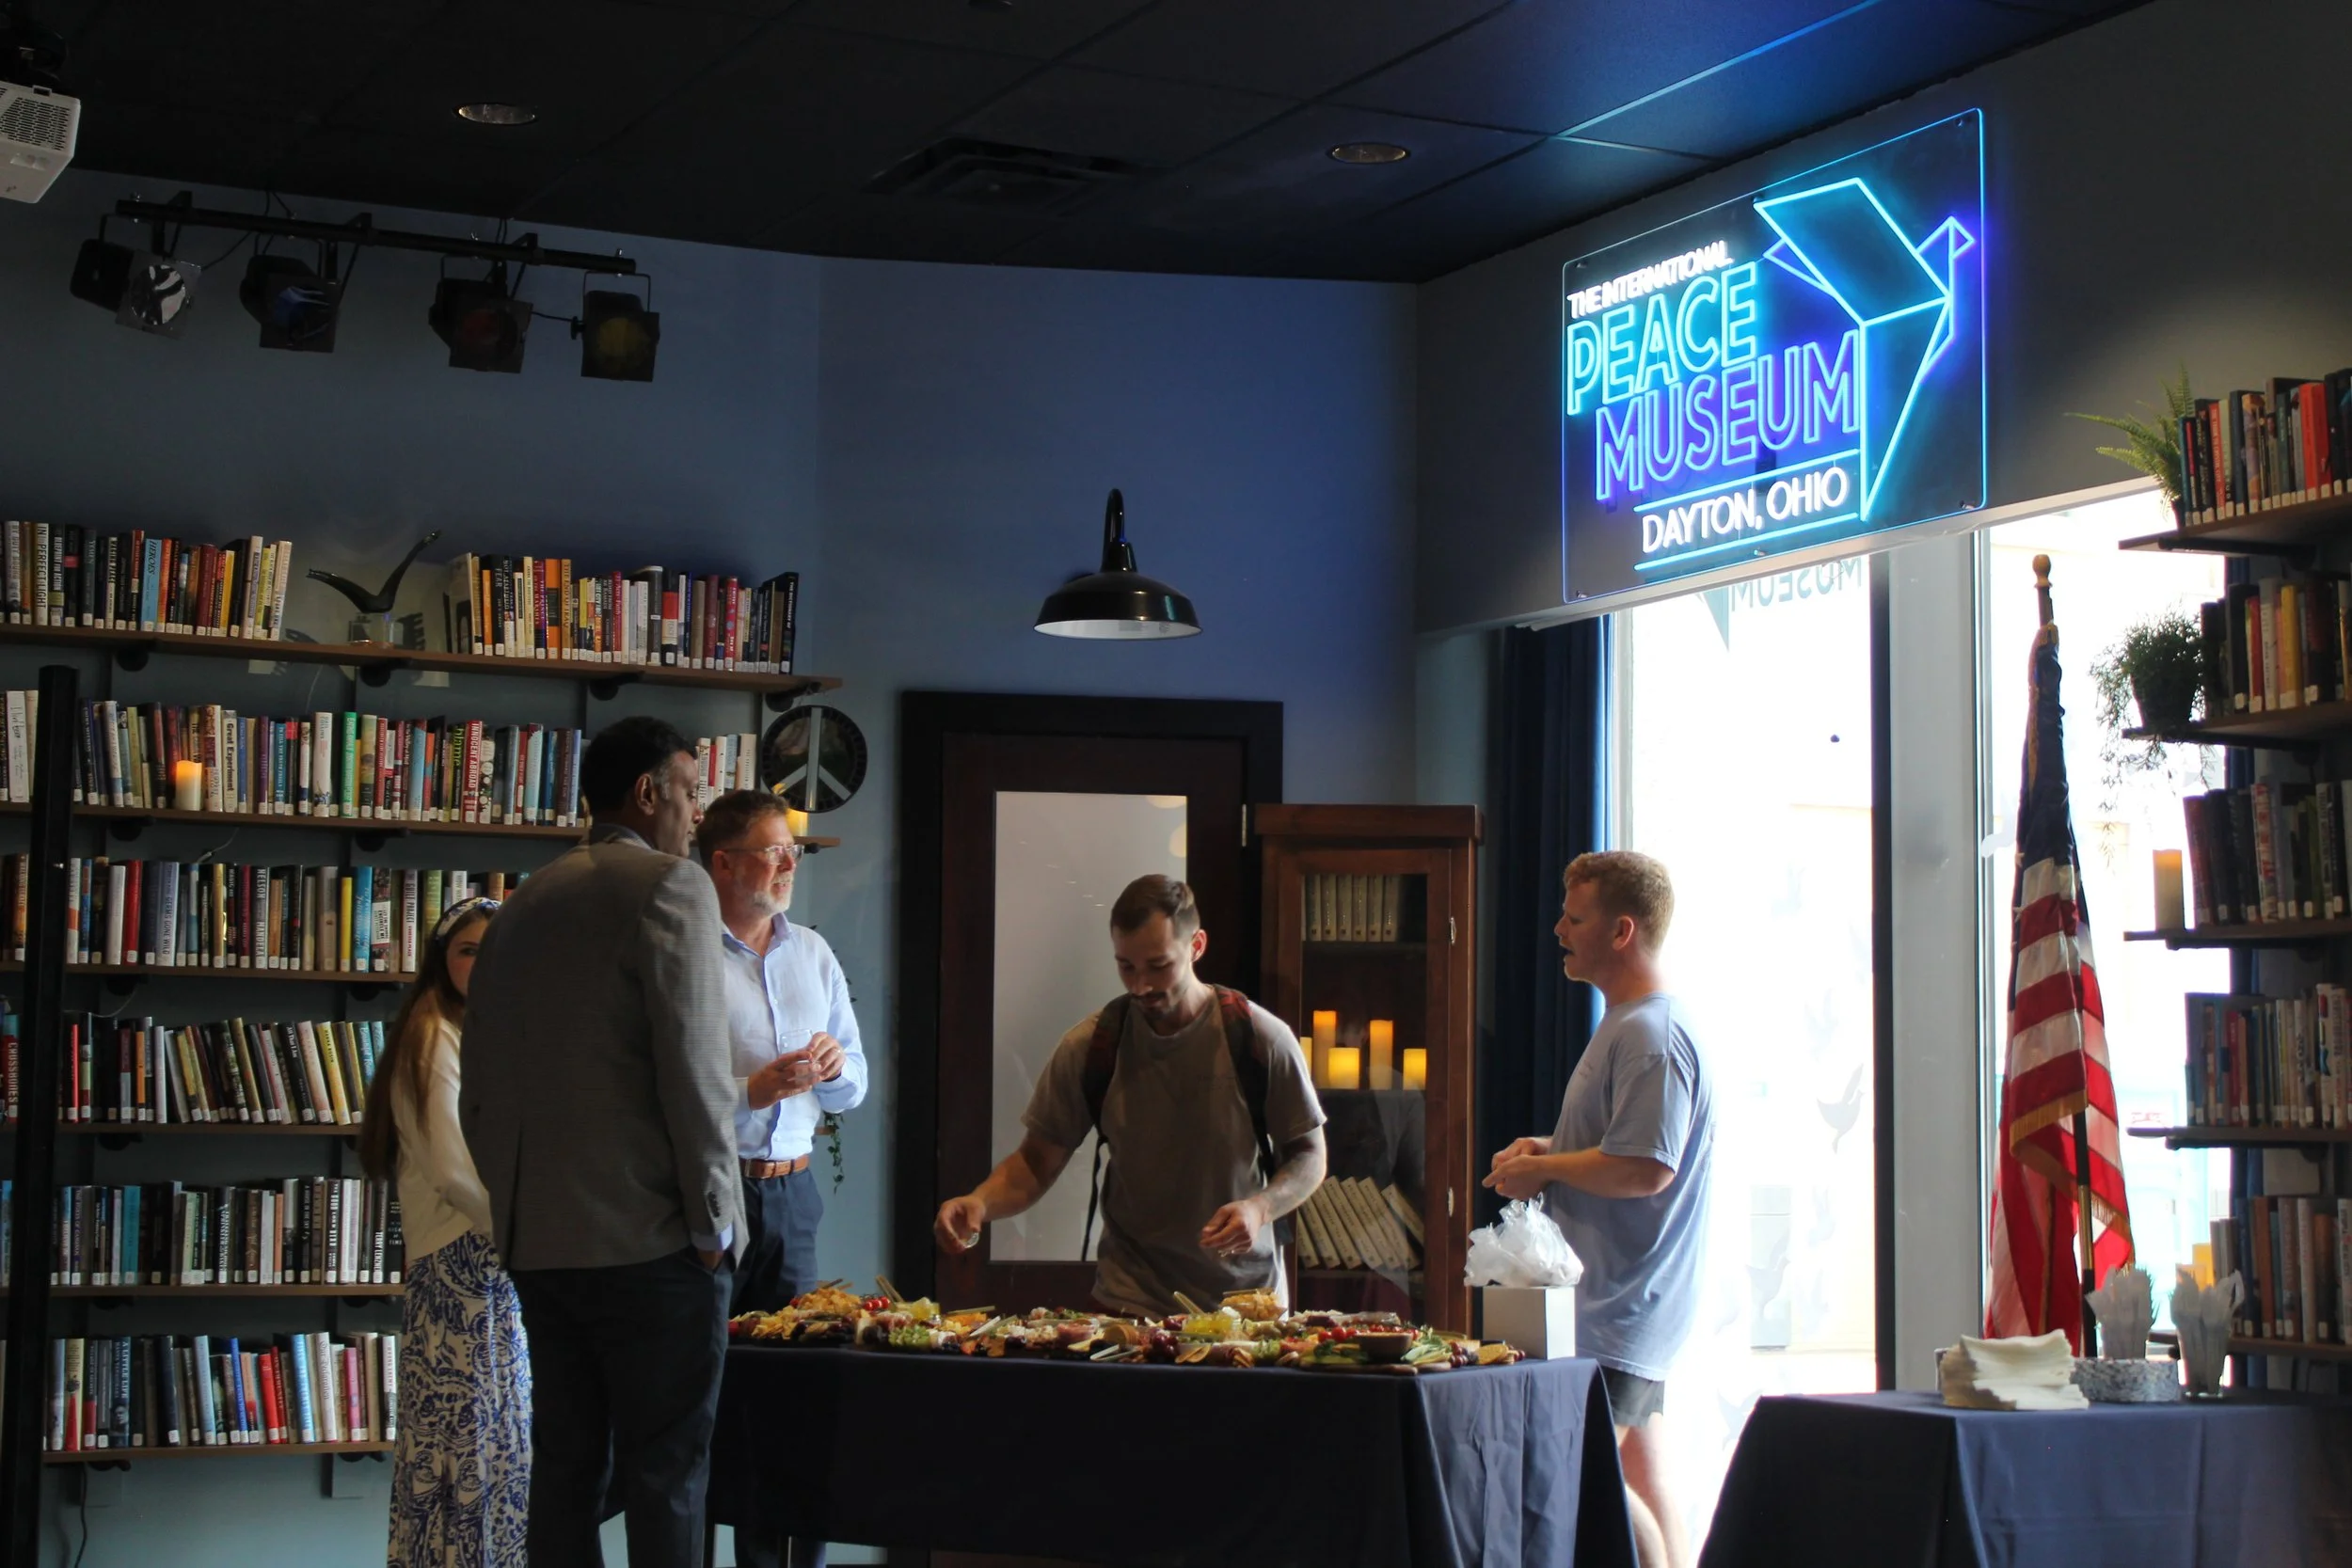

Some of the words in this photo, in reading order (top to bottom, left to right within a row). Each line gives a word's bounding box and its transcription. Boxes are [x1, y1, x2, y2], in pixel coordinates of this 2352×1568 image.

[1566, 285, 1602, 319] THE
[1601, 240, 1734, 308] INTERNATIONAL
[1566, 261, 1756, 416] PEACE
[1596, 330, 1862, 501] MUSEUM
[1642, 489, 1763, 554] DAYTON,
[1766, 466, 1850, 520] OHIO
[38, 527, 46, 535] IN
[38, 544, 47, 580] PERFECT
[53, 536, 63, 562] BLUEPRINT
[148, 540, 157, 575] HEROES
[53, 572, 62, 591] ACTION
[37, 584, 47, 609] LIGHT
[564, 596, 570, 606] OF
[226, 722, 234, 745] Great
[469, 722, 480, 758] INNOCENT
[453, 727, 465, 768] blame
[226, 747, 235, 792] Experiment
[468, 760, 478, 788] ABROAD
[256, 868, 265, 898] NELSON
[405, 882, 416, 900] GUILT
[164, 896, 173, 919] GERMS
[406, 901, 416, 923] PROJECT
[162, 939, 171, 954] WILD
[255, 921, 265, 956] MANDELA
[8, 1042, 20, 1102] CROSSBONES
[329, 1195, 339, 1210] GOOD
[329, 1230, 338, 1246] BIRD
[374, 1232, 384, 1249] TERRY
